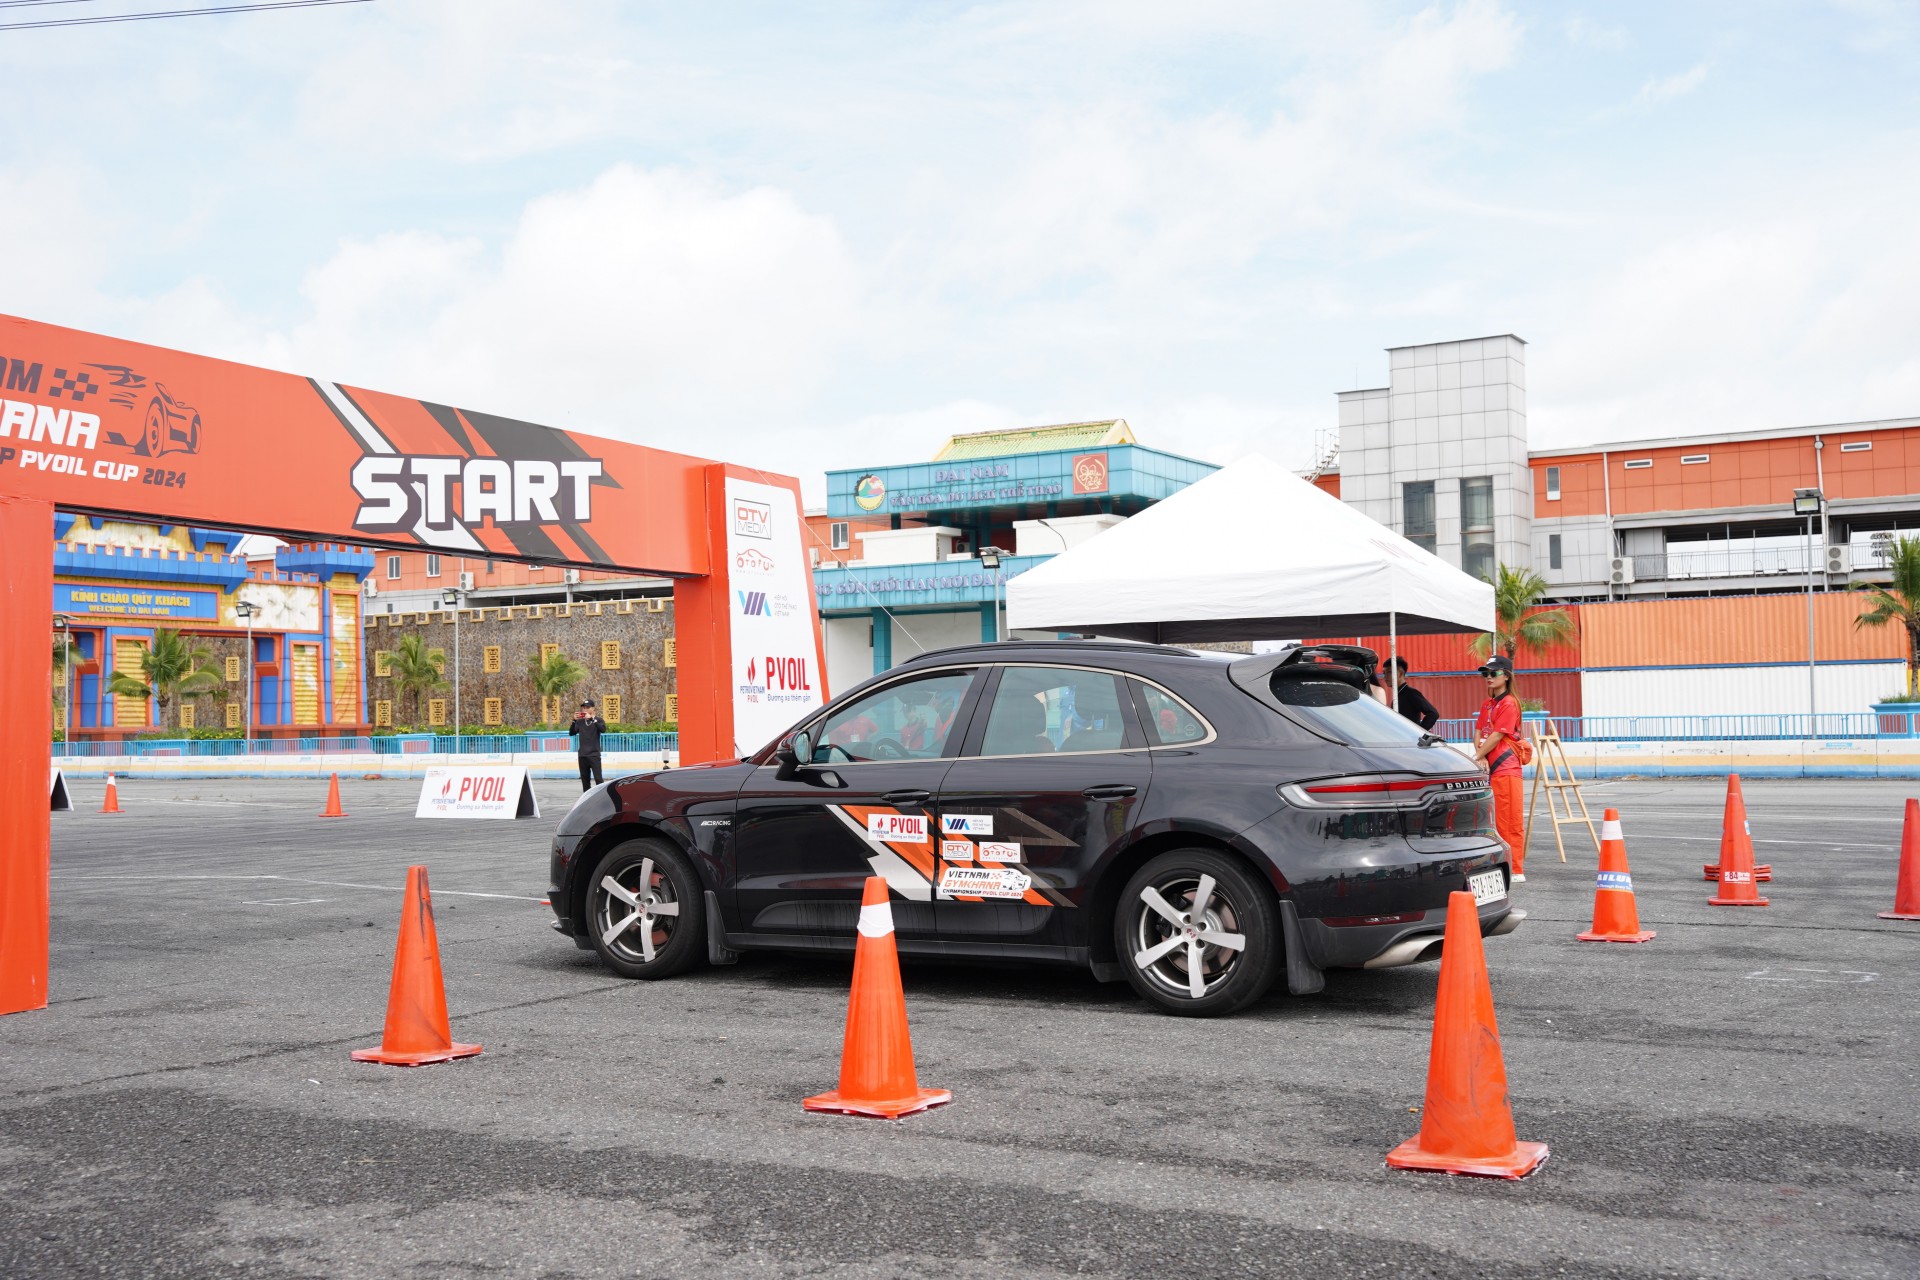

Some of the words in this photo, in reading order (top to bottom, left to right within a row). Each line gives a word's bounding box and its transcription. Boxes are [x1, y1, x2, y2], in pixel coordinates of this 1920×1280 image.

[0, 355, 44, 394] M
[0, 398, 101, 450] ANA
[19, 449, 88, 477] PVOIL
[92, 460, 139, 482] CUP
[142, 467, 187, 489] 2024
[970, 464, 1009, 481] NAM
[352, 455, 602, 525] START
[947, 489, 965, 502] DU
[737, 507, 768, 524] OTV
[903, 577, 938, 594] HẠN
[71, 588, 98, 603] KÍNH
[100, 590, 130, 604] CHÀO
[155, 592, 191, 607] KHÁCH
[128, 606, 137, 614] TO
[765, 656, 811, 691] PVOIL
[458, 777, 506, 802] PVOIL
[890, 817, 923, 835] PVOIL
[946, 844, 969, 852] OTV
[948, 870, 990, 879] VIETNAM
